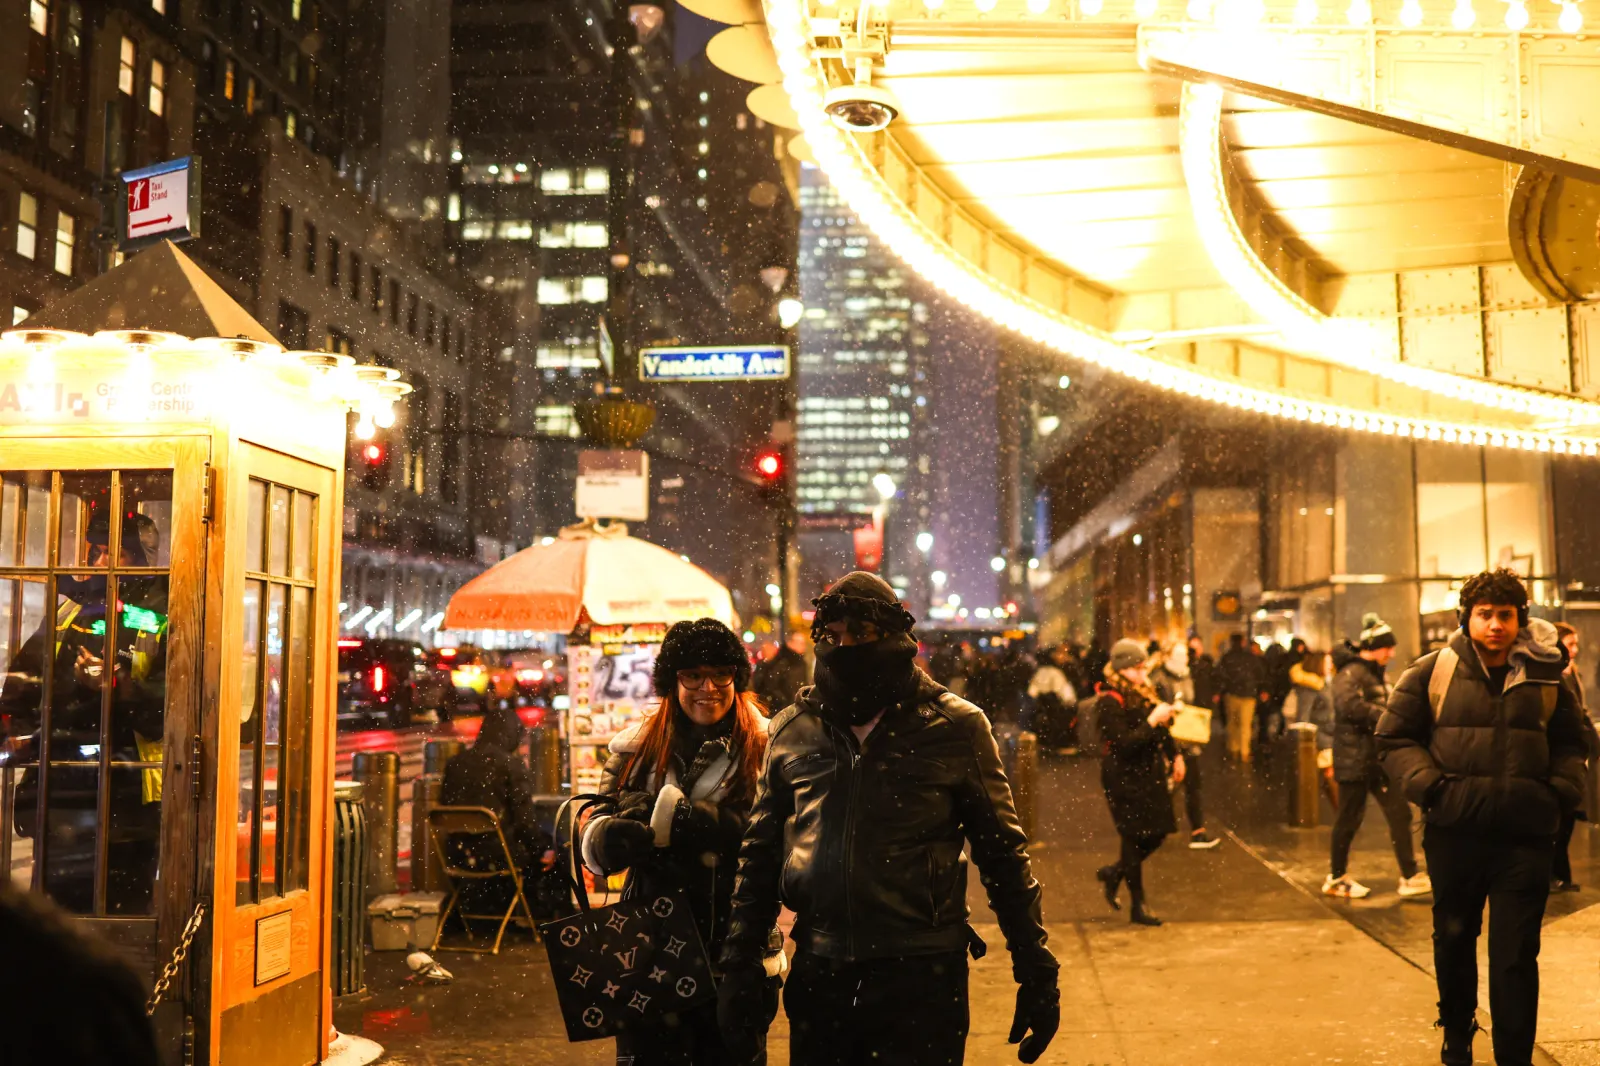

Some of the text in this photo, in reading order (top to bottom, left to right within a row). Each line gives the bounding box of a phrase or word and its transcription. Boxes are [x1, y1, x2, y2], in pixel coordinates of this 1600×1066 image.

[151, 182, 163, 191] Taxi
[151, 190, 168, 201] Stand
[643, 353, 785, 376] Vanderbilt Ave
[151, 381, 194, 395] Centr
[0, 383, 63, 412] AI
[106, 397, 195, 415] Pership
